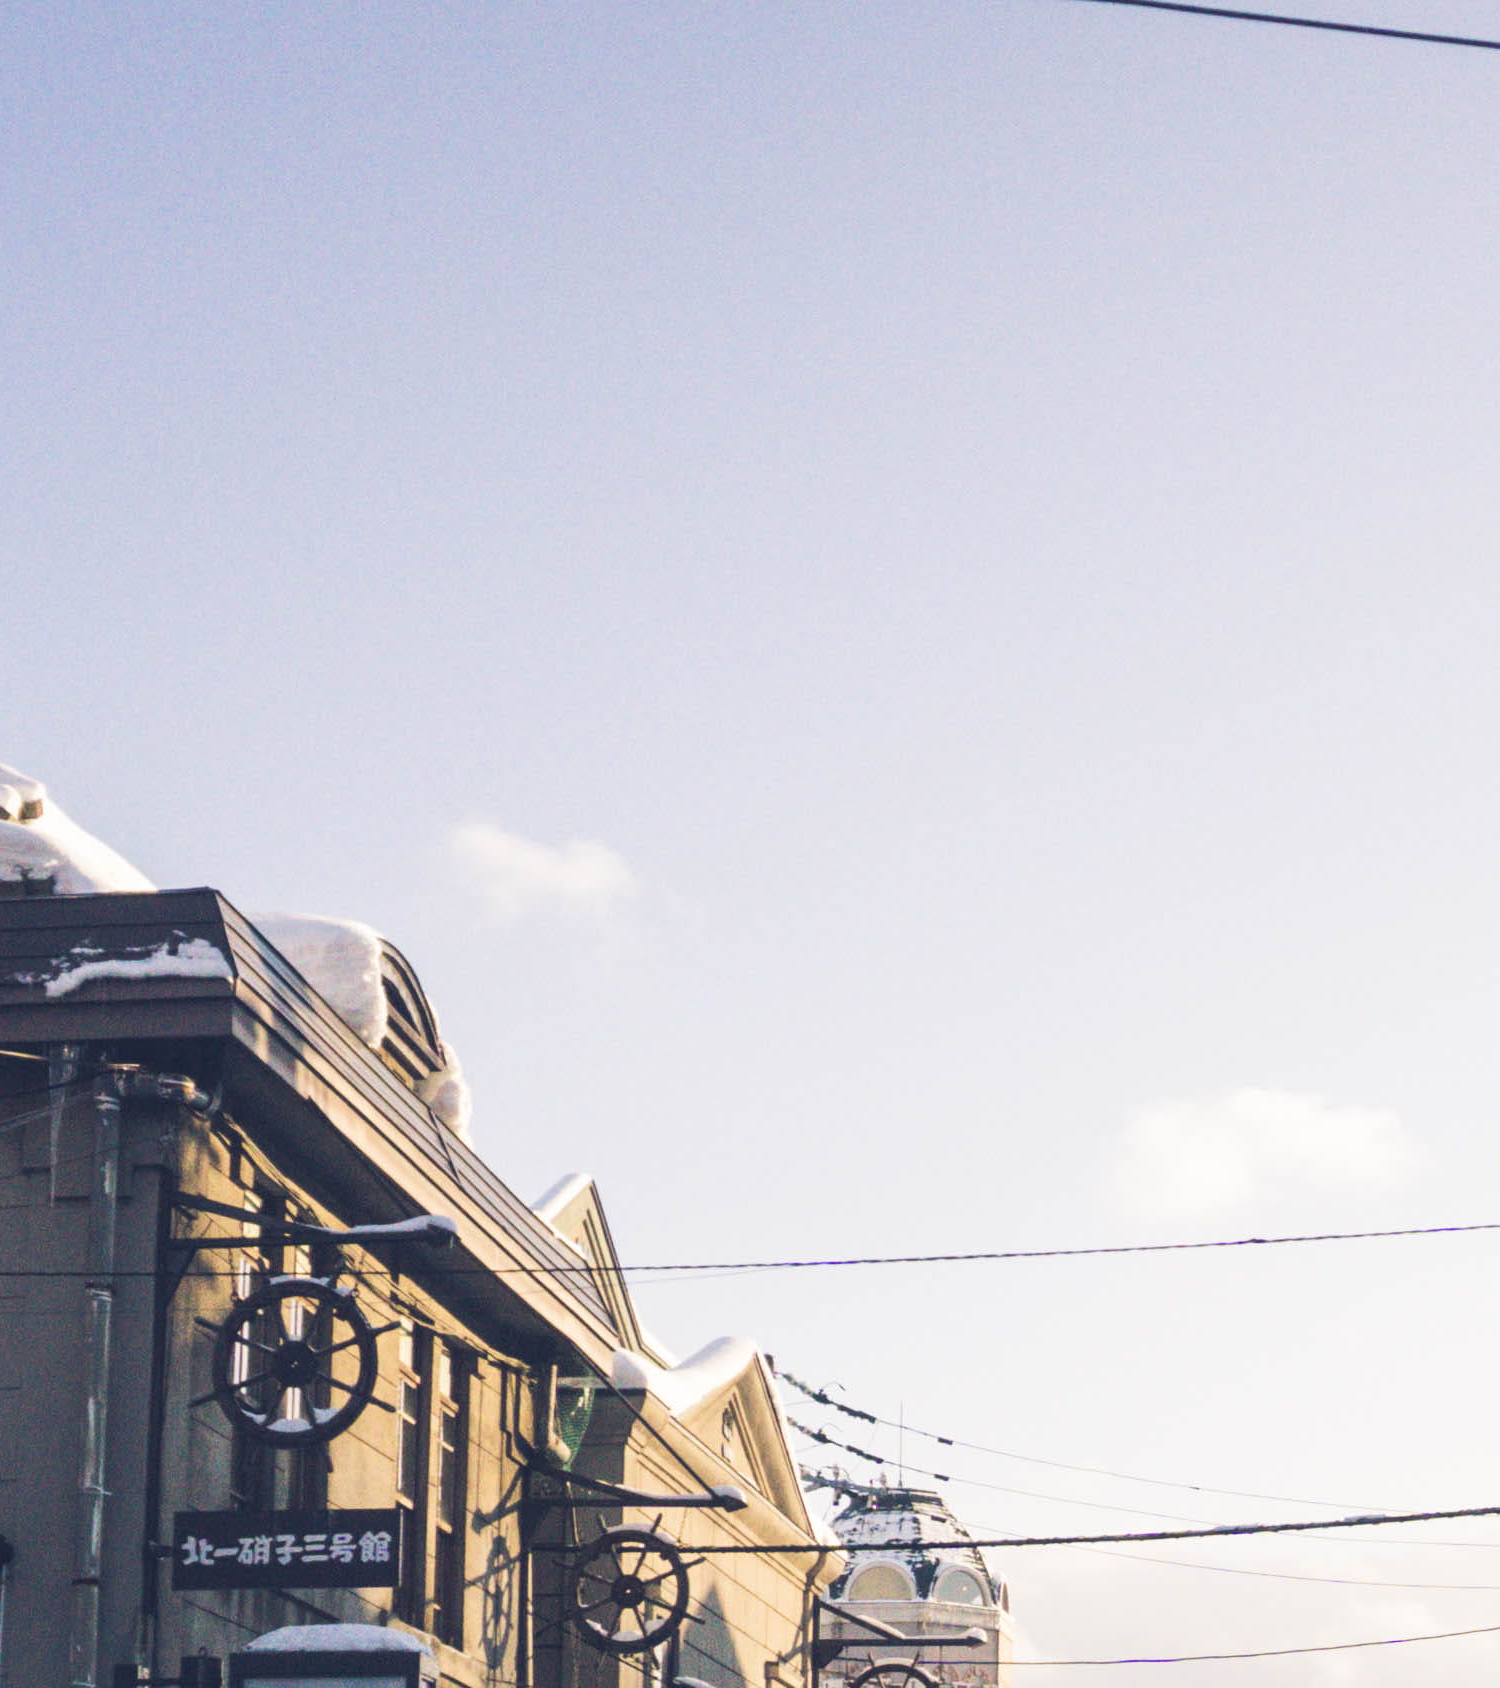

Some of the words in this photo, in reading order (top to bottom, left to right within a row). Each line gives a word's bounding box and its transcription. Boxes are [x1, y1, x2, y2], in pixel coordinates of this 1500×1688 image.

[180, 1532, 391, 1566] 北一硝子三号館
